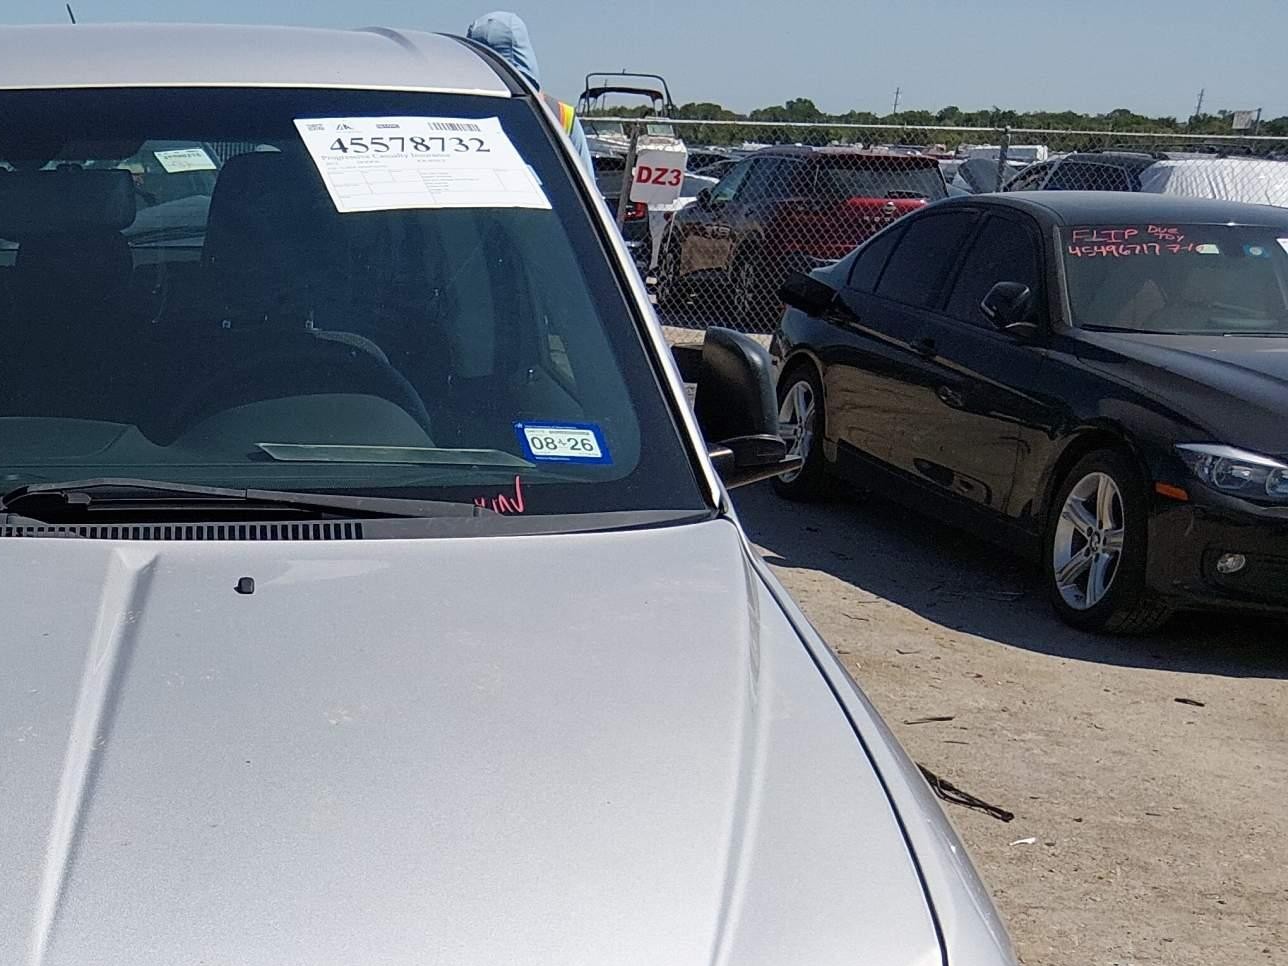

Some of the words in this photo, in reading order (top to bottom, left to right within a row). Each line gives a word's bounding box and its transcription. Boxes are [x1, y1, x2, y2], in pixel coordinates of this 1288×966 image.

[329, 136, 491, 154] 45578732
[635, 165, 682, 187] DZ3
[1072, 228, 1139, 243] FLIP
[1068, 242, 1160, 257] 45496717
[530, 436, 558, 450] 08
[567, 437, 594, 451] 26
